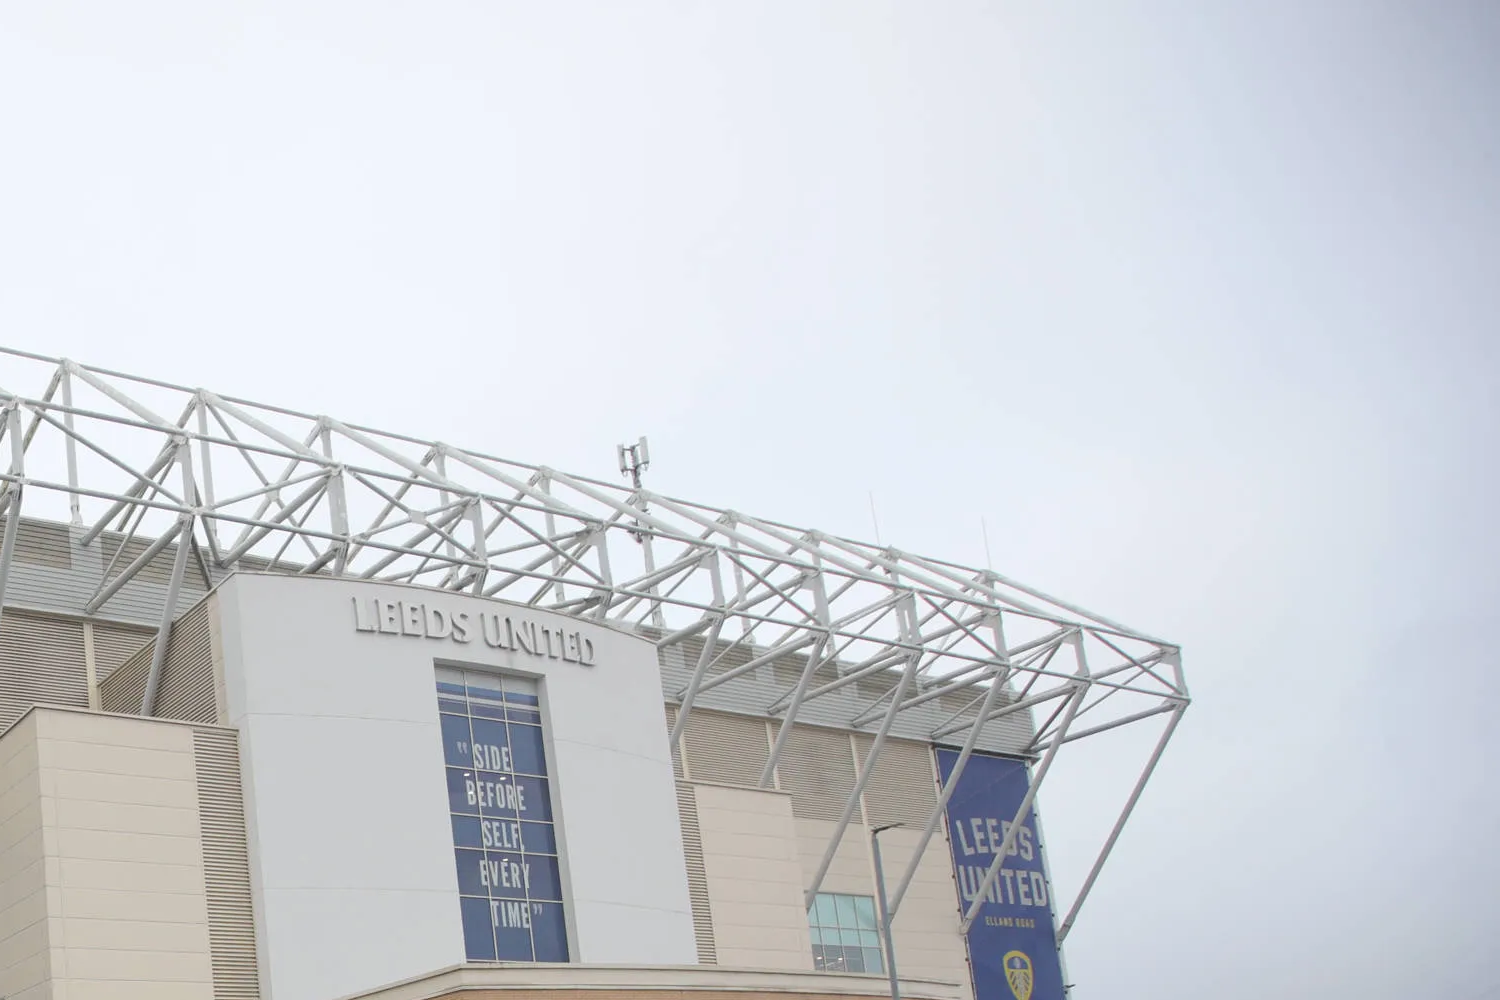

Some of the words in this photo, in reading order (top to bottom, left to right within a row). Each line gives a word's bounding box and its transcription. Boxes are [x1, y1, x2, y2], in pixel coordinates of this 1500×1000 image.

[351, 597, 471, 644] LEEDS
[480, 612, 596, 666] UNITED
[465, 779, 527, 811] BEFORE
[479, 859, 530, 889] EVERY
